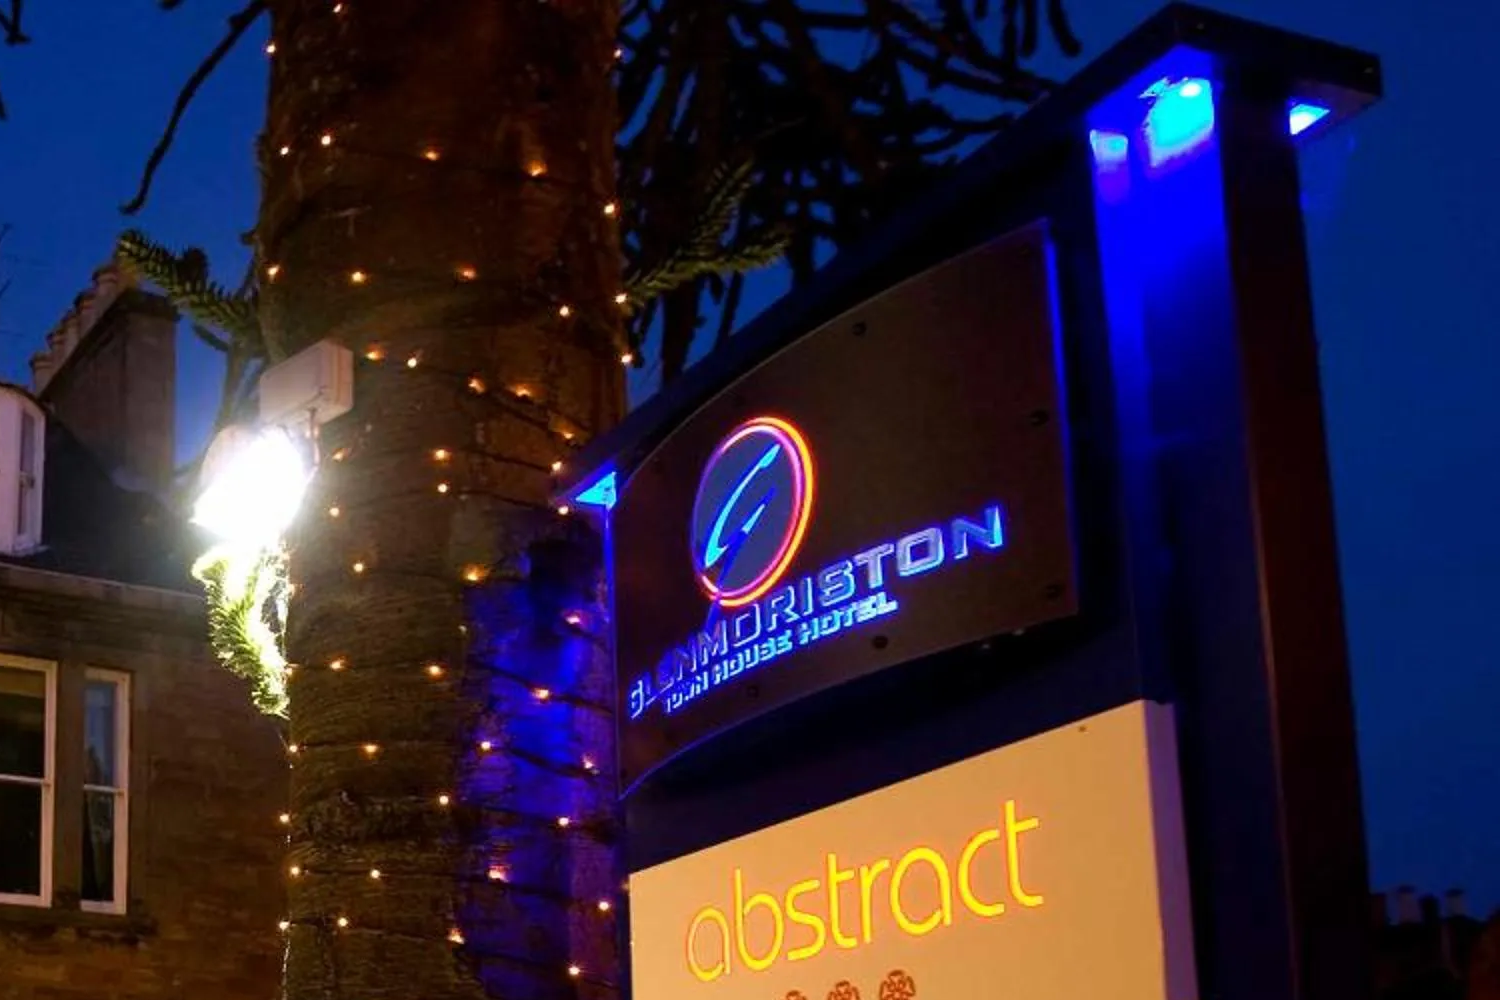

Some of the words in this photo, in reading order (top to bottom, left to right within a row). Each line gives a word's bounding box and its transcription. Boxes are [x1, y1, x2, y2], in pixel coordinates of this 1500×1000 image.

[711, 628, 794, 686] HOUSE
[798, 590, 899, 647] HOTEL
[686, 799, 1045, 982] abstract
